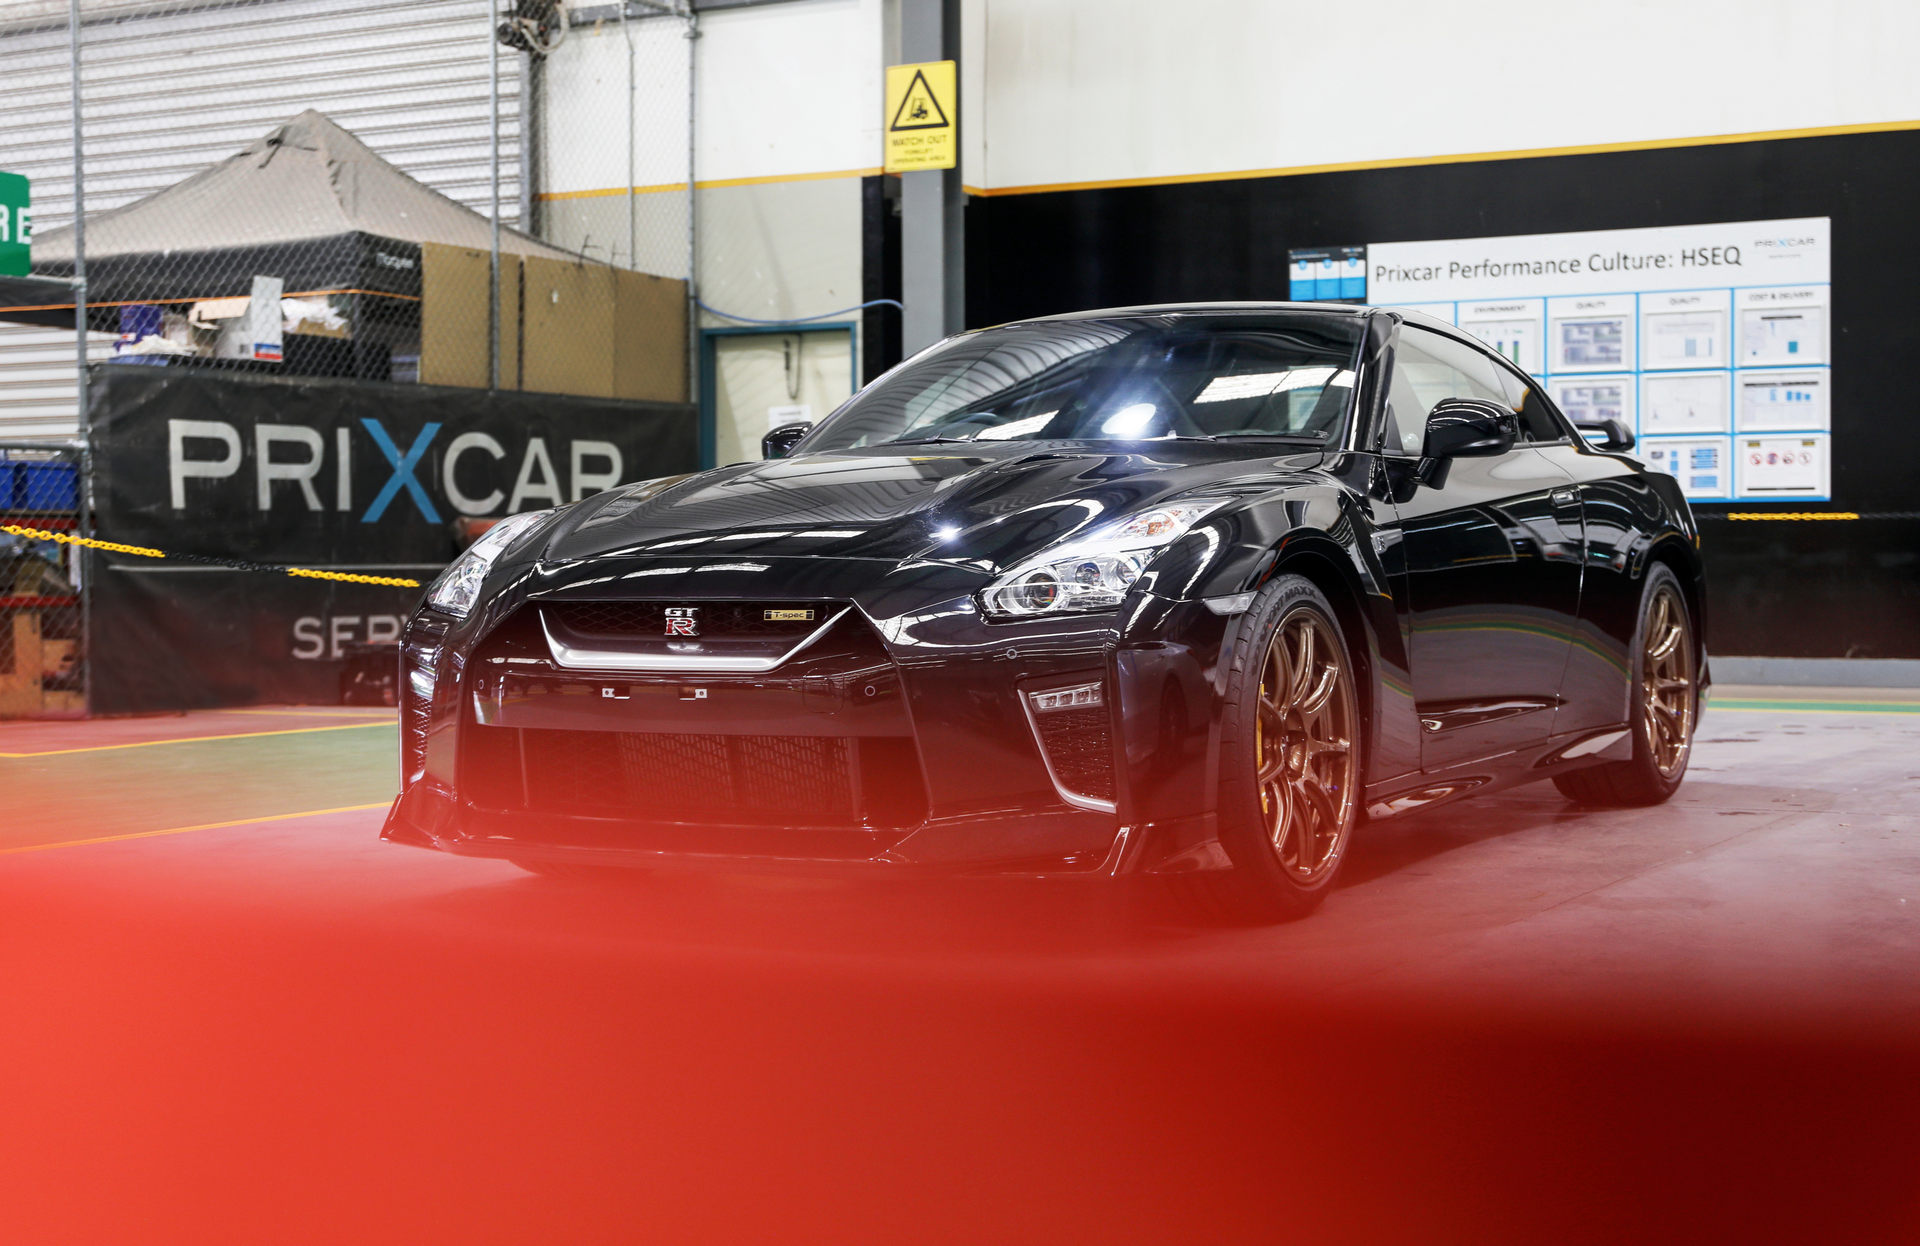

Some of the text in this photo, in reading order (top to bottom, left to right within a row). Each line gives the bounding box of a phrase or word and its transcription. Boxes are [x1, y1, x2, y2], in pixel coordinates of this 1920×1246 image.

[893, 134, 947, 147] WATCH OUT
[1375, 246, 1743, 283] Prixcar Performance Culture: HSEQ
[168, 418, 624, 524] PRIXCAR
[664, 607, 699, 617] GT
[772, 611, 805, 619] T-spec
[663, 617, 700, 636] R
[291, 614, 409, 659] SER
